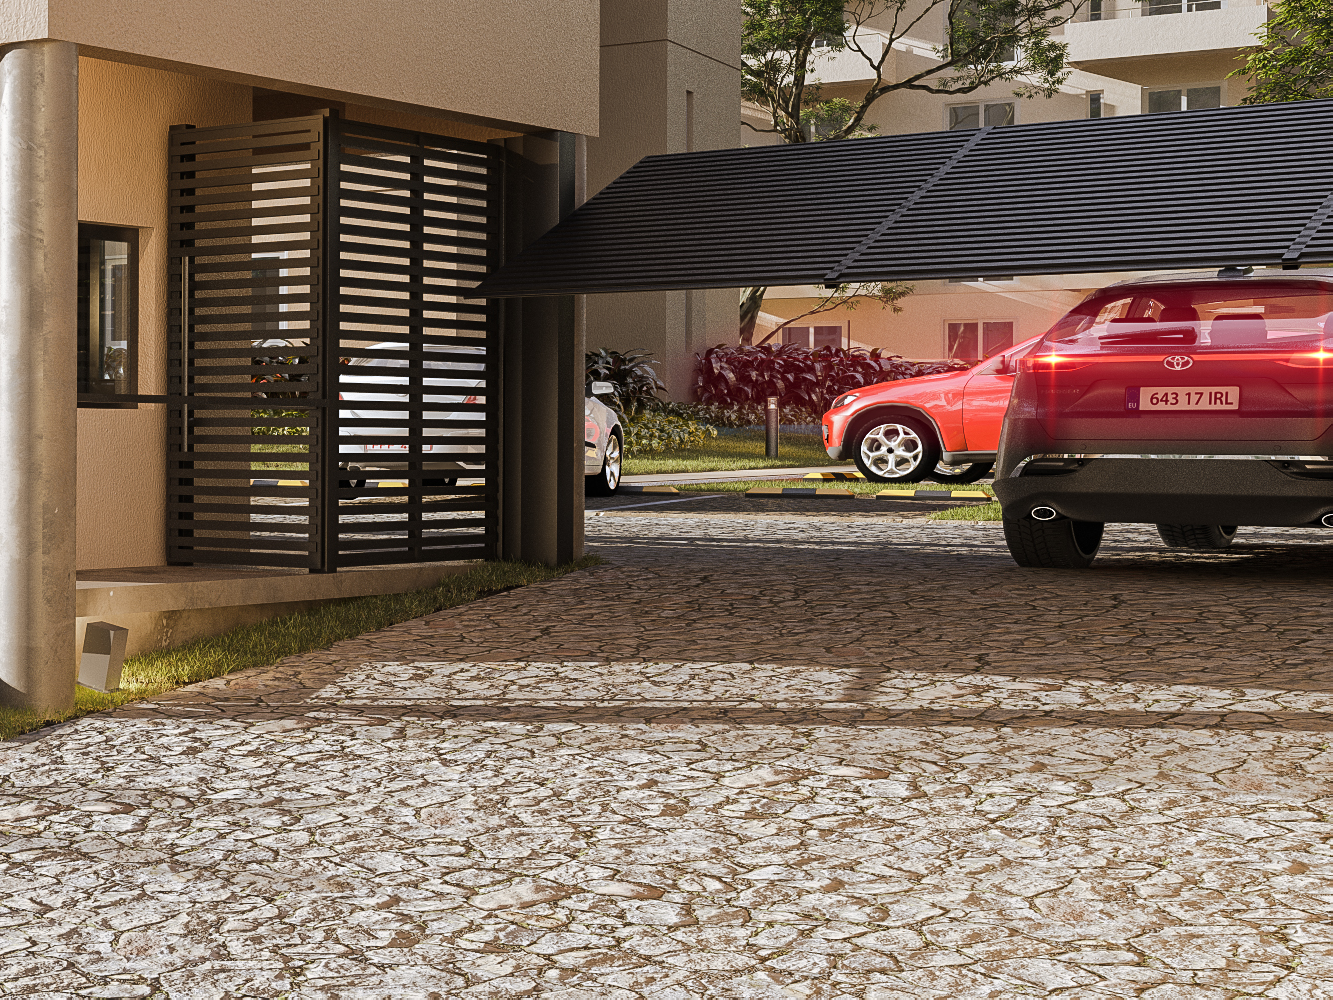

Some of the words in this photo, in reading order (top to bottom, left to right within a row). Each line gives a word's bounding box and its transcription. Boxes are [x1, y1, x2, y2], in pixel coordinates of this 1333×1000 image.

[1150, 391, 1179, 406] 643
[1185, 391, 1204, 406] 17
[1208, 391, 1234, 406] IRL
